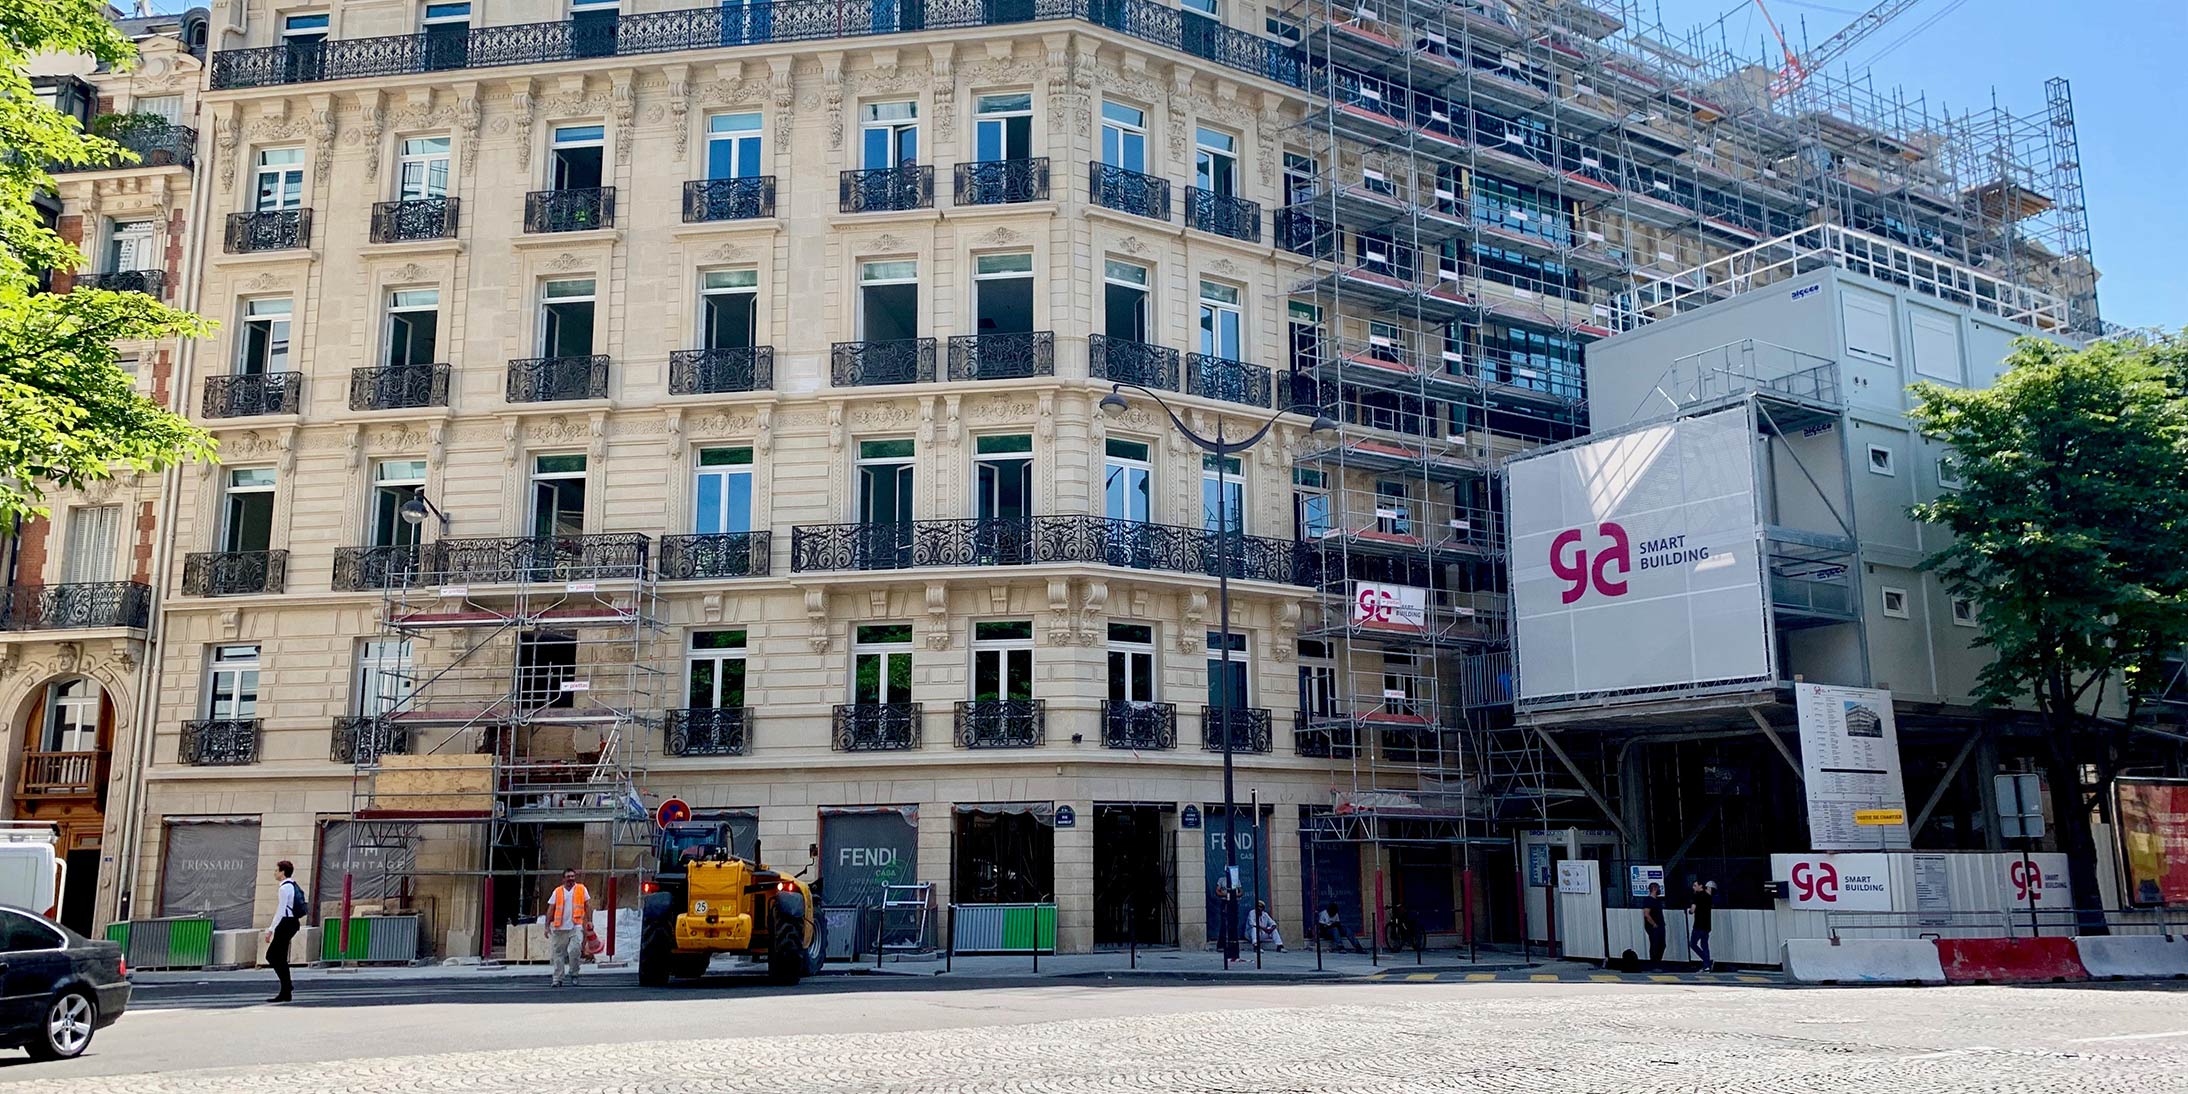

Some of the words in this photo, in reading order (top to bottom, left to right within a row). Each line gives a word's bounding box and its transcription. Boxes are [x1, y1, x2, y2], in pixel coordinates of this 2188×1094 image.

[1639, 535, 1686, 555] SMART
[1640, 547, 1709, 570] BUILDING
[1211, 833, 1255, 850] FEND
[181, 859, 244, 870] TRUSSARDI
[331, 861, 404, 870] HERITAGE
[840, 848, 896, 866] FENDI
[697, 902, 706, 912] 25
